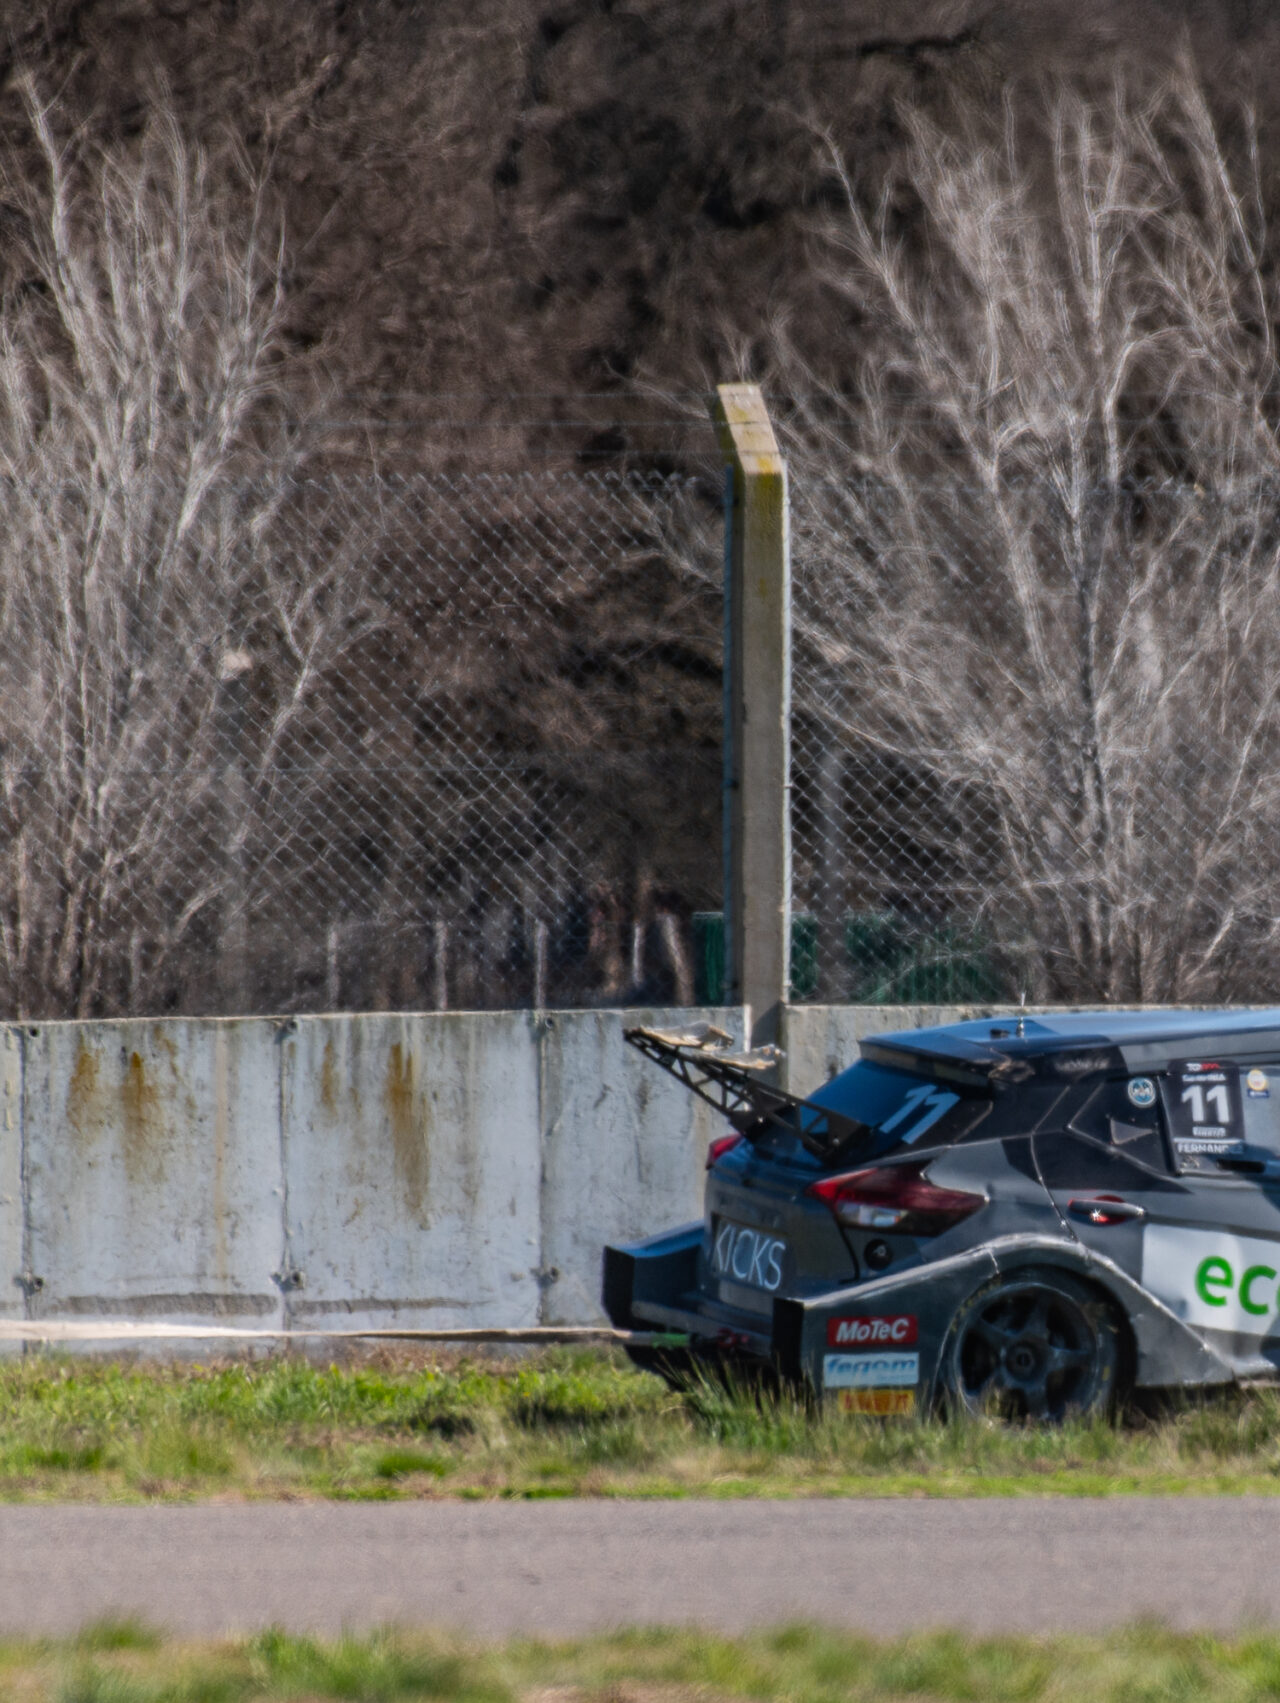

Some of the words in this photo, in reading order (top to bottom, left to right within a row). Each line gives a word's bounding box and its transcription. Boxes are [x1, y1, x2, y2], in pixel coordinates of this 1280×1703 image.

[879, 1084, 961, 1145] 11
[1181, 1085, 1230, 1124] 11
[713, 1224, 787, 1290] KICKS
[836, 1318, 909, 1343] MoTeC
